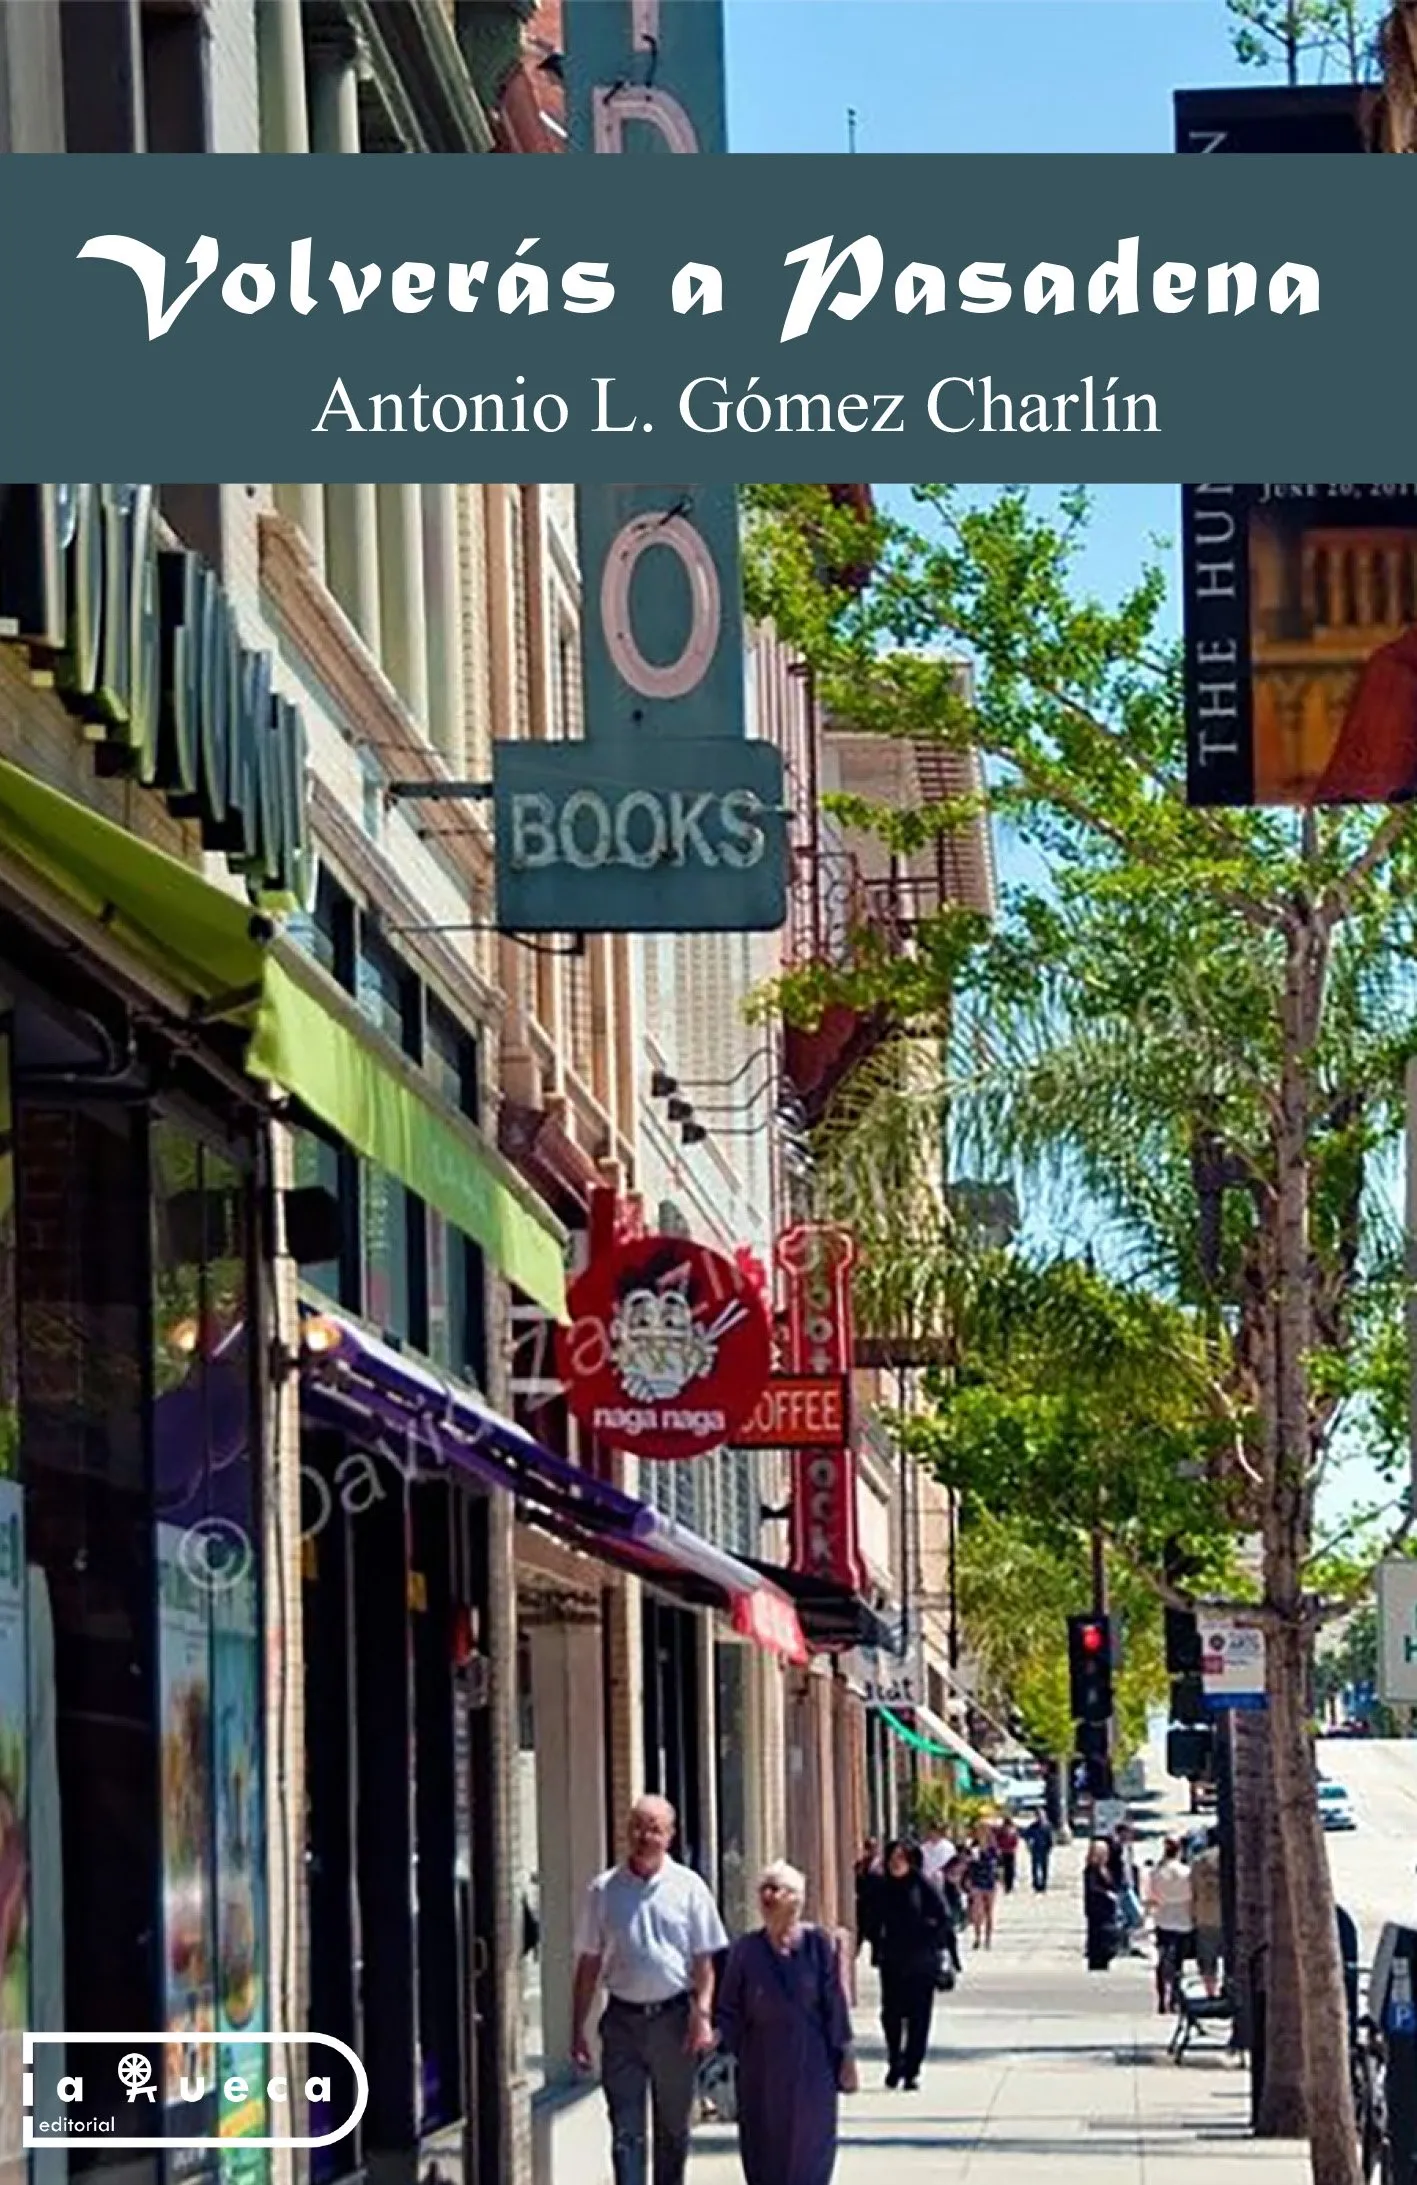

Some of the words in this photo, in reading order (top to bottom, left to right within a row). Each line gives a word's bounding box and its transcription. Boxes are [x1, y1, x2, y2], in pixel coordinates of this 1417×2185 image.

[1196, 637, 1238, 767] THE
[511, 789, 766, 870] BOOKS
[593, 1407, 658, 1436] naga
[662, 1409, 727, 1437] naga
[741, 1390, 840, 1433] OFFEE
